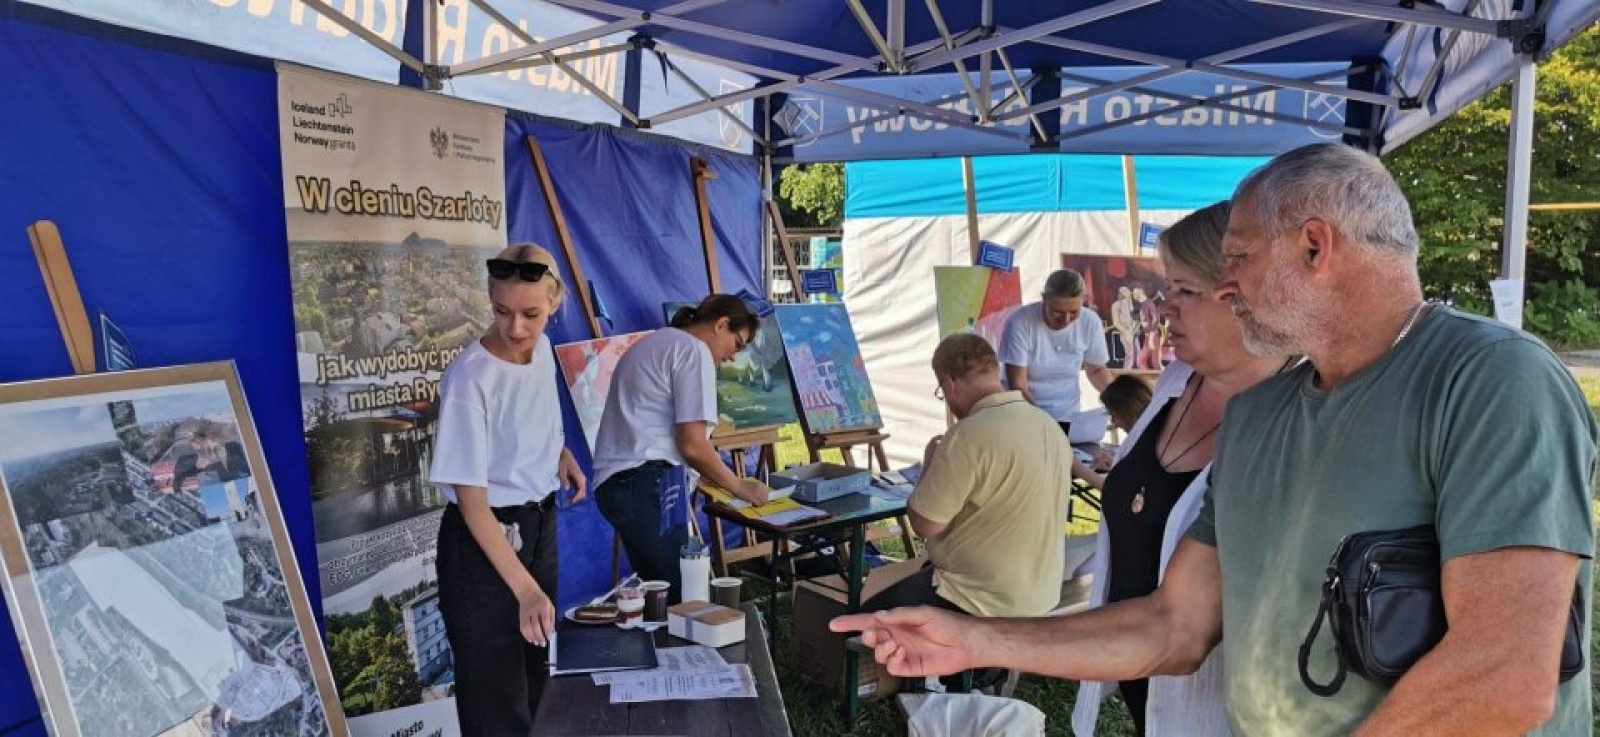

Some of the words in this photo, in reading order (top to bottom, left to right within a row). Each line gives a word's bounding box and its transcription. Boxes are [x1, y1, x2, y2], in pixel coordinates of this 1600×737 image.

[291, 99, 325, 115] Iceland
[292, 116, 354, 135] Liechtenstein
[294, 131, 329, 149] Norway
[296, 175, 331, 214] W
[335, 180, 415, 218] cieniu
[416, 186, 501, 229] Szarloty
[317, 353, 358, 386] jak
[358, 345, 438, 380] wydobyć
[348, 381, 412, 412] miasta
